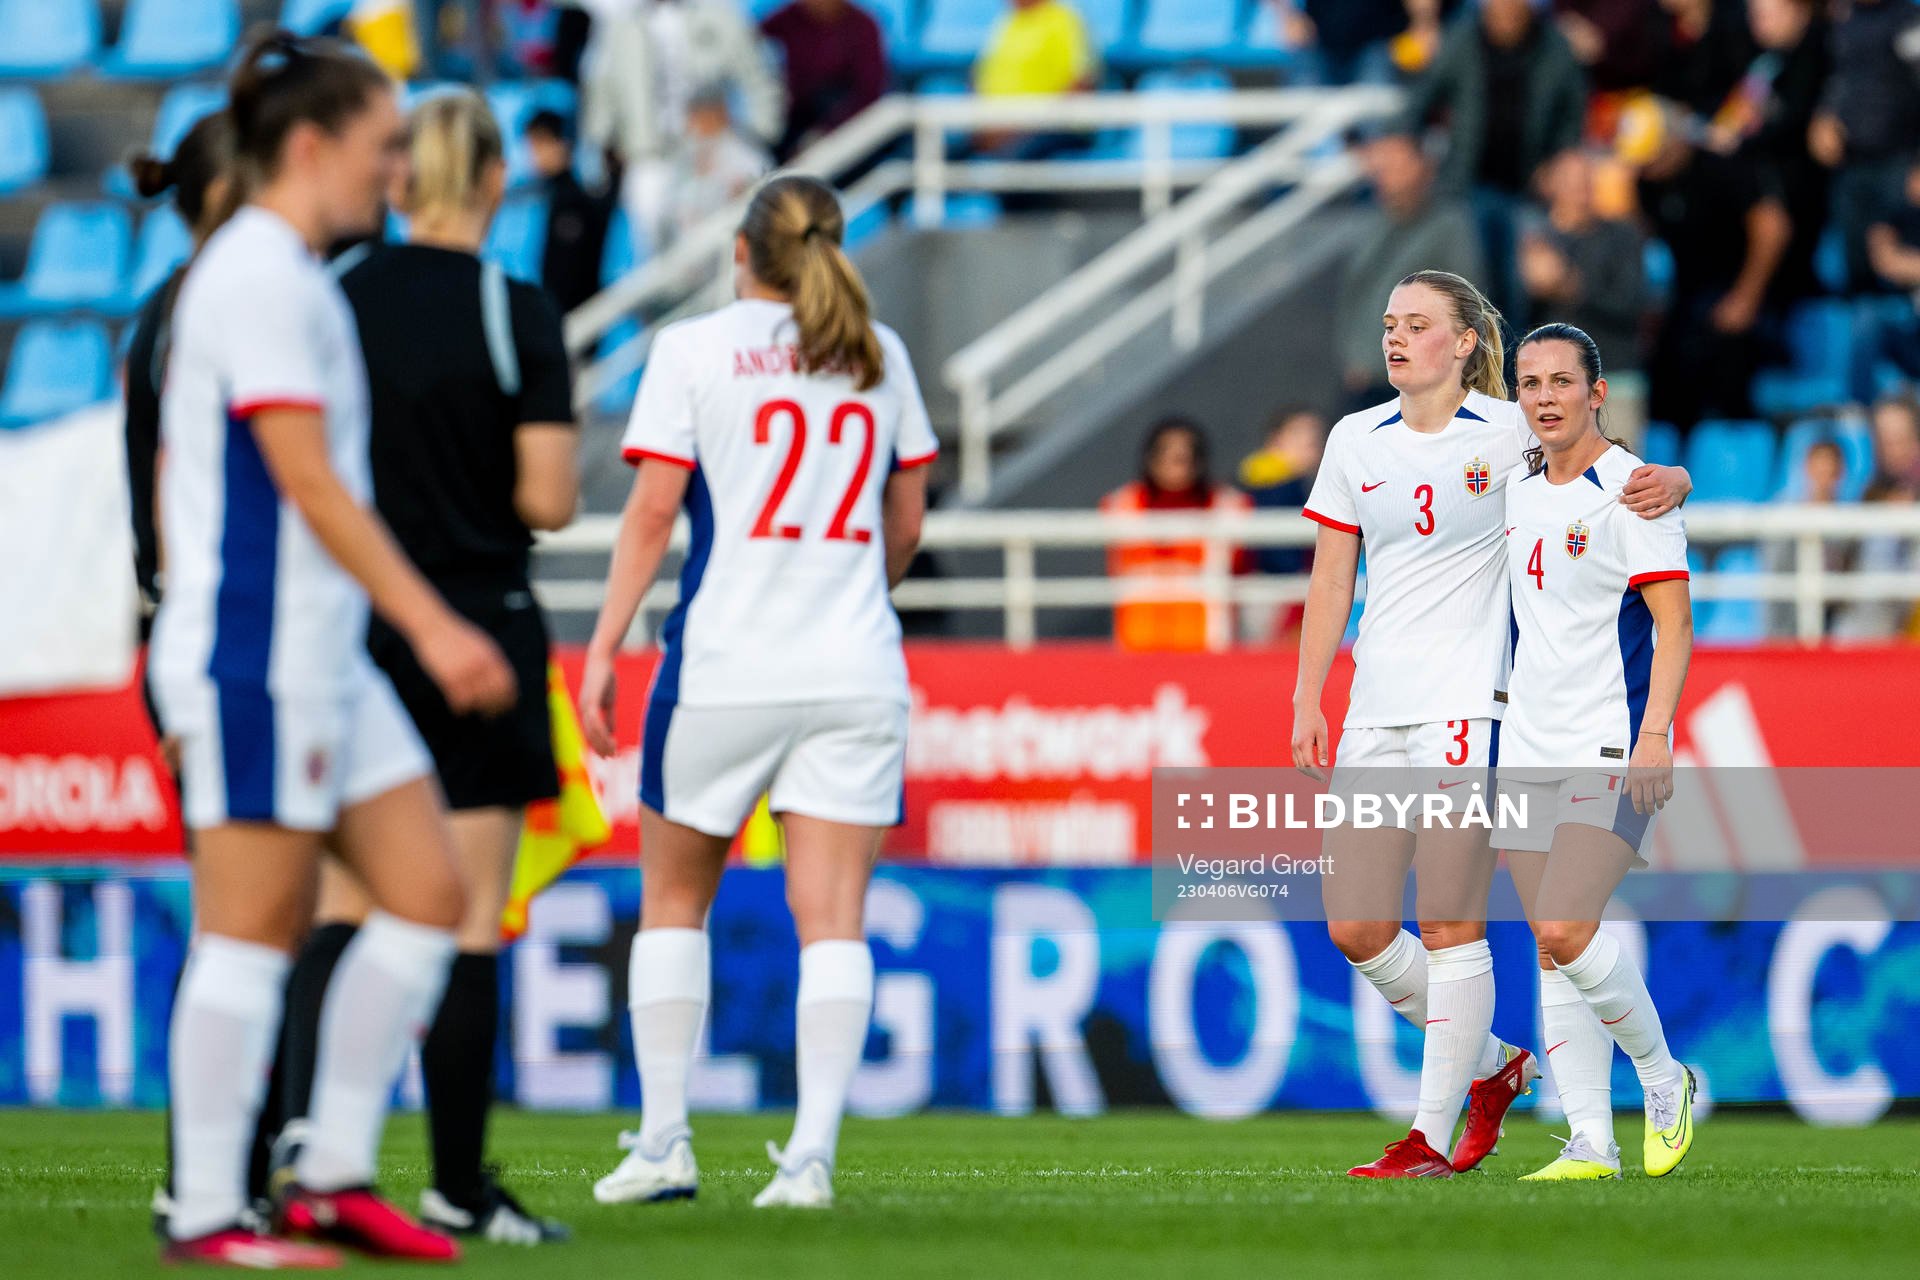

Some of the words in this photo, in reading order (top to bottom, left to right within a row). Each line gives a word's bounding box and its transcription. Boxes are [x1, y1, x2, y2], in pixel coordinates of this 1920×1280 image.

[749, 398, 875, 543] 22
[1413, 484, 1435, 536] 3
[1527, 538, 1545, 590] 4
[1445, 719, 1469, 766] 3
